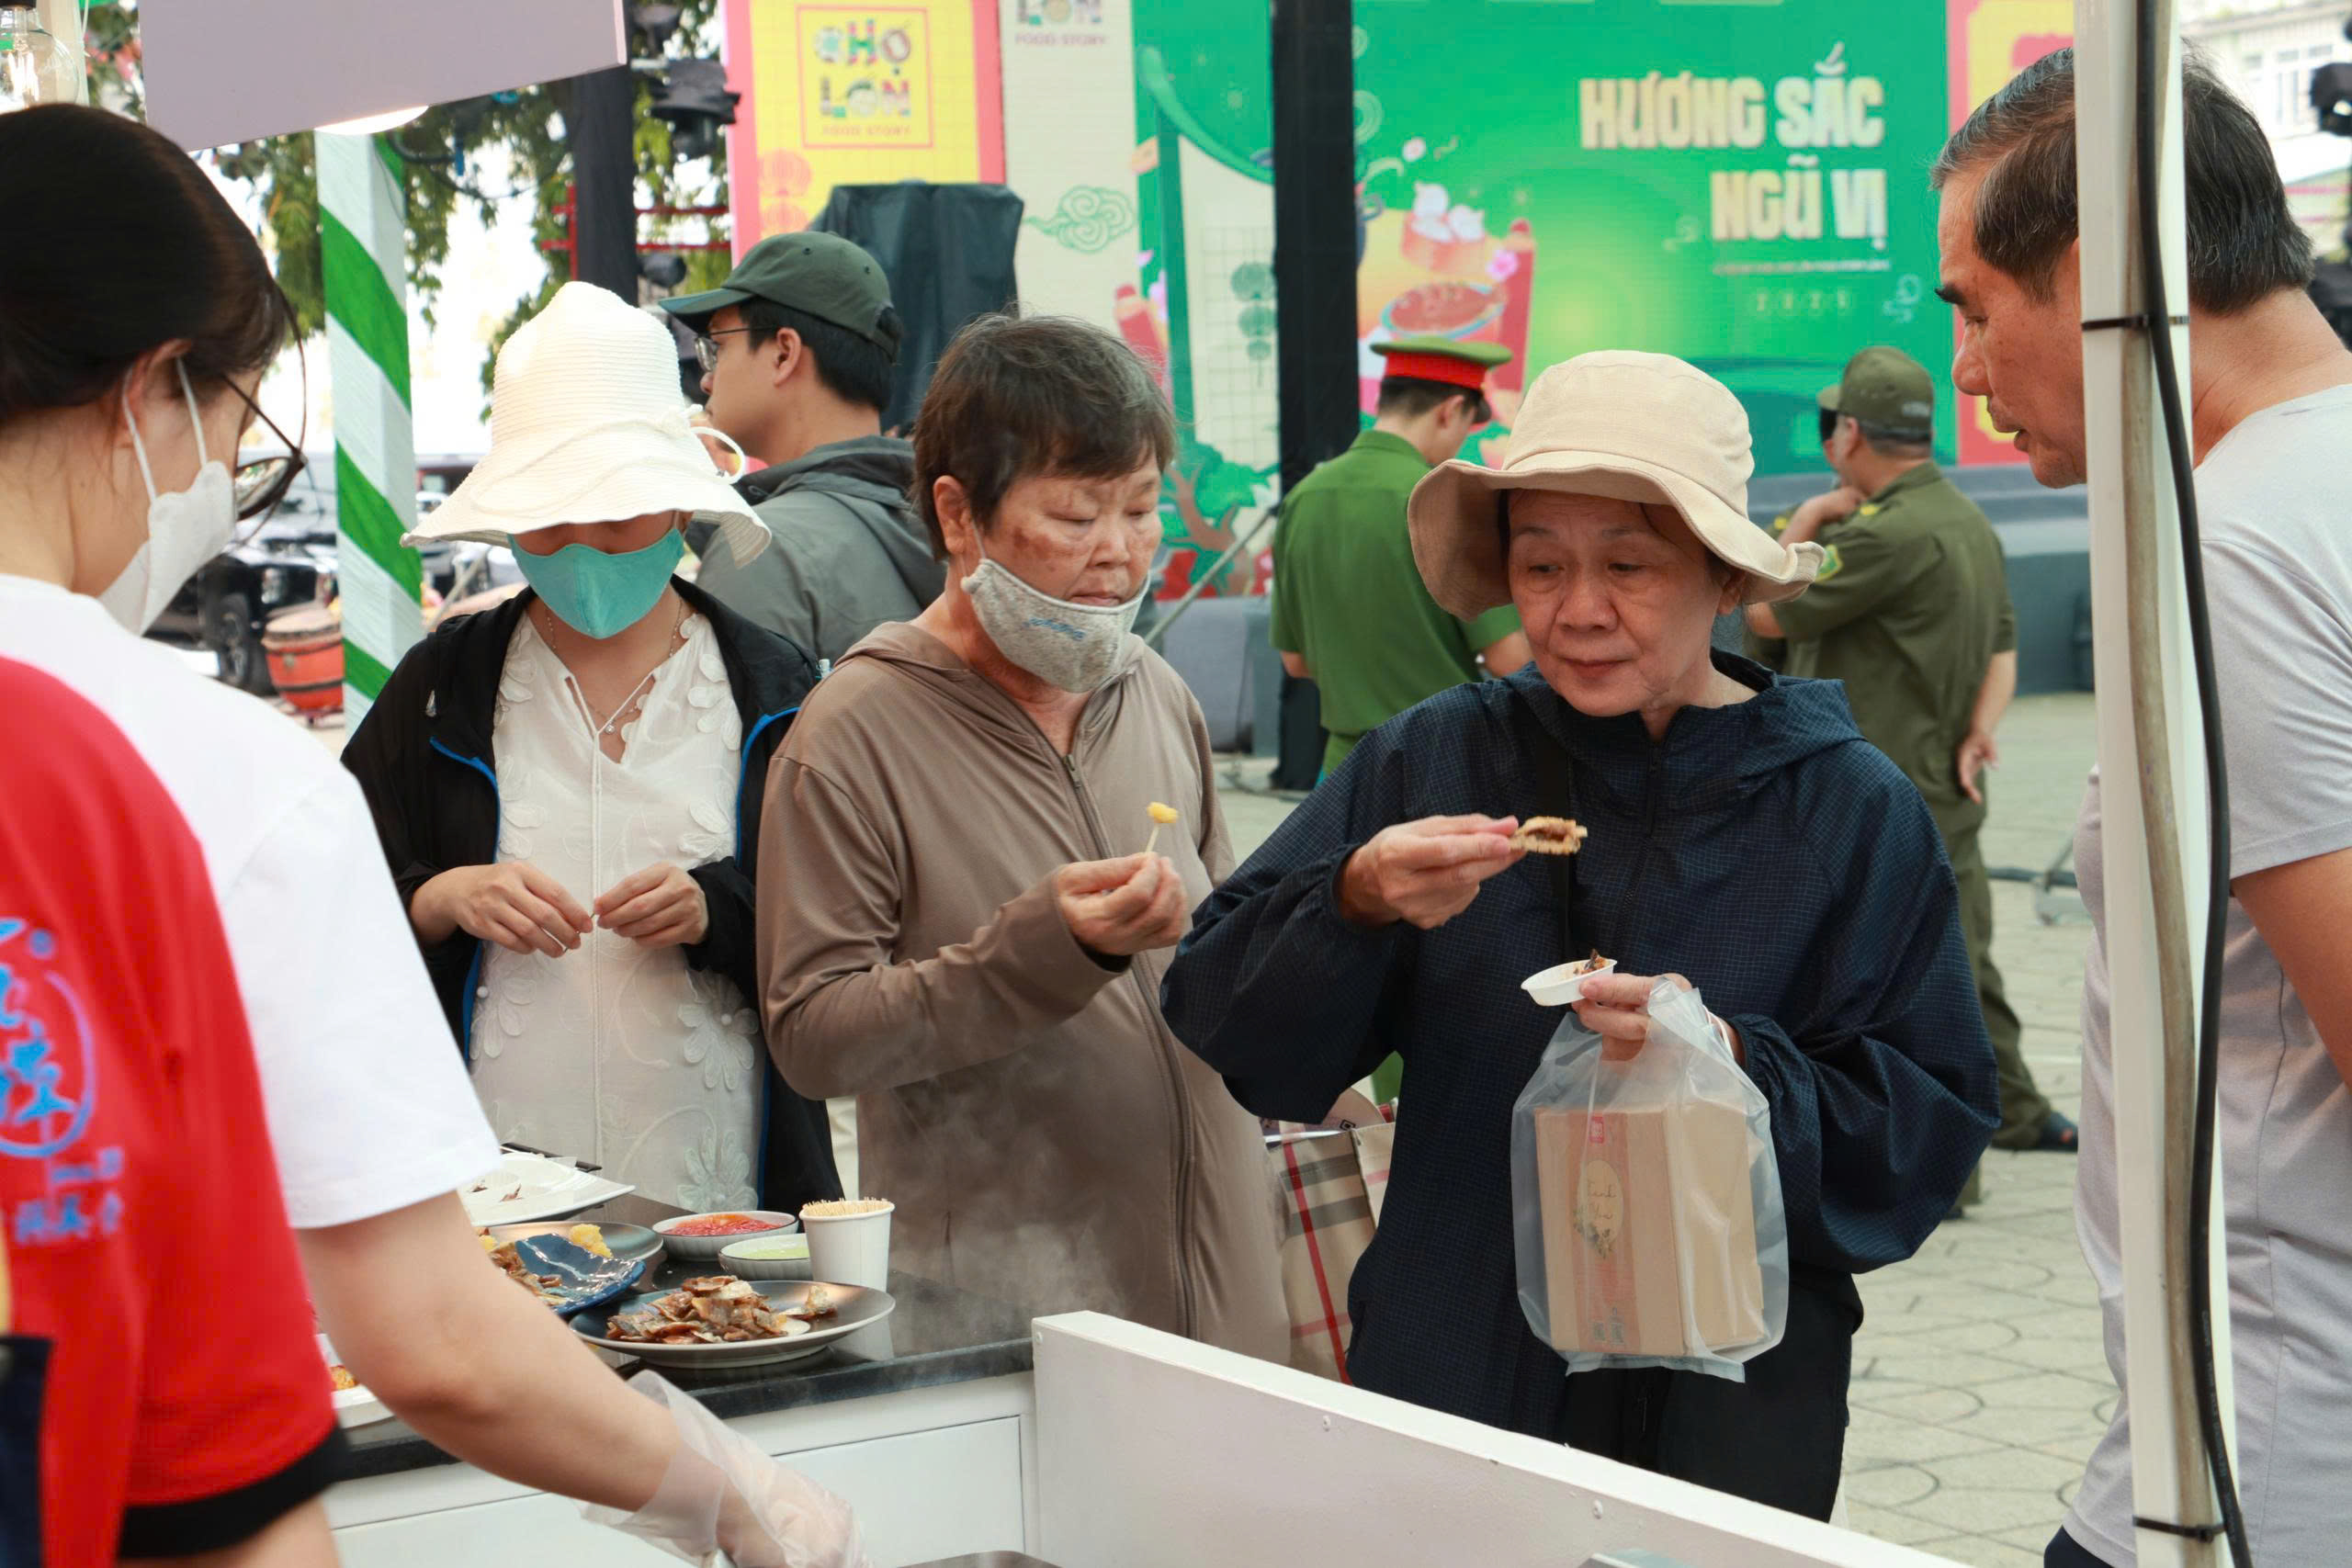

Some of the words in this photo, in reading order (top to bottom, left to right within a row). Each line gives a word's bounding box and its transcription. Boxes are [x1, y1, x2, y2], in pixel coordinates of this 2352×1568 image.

[1579, 70, 1766, 150] HƯƠNG
[1773, 41, 1884, 148] SẮC
[1710, 154, 1823, 241] NGŨ
[1830, 168, 1888, 251] VỊ
